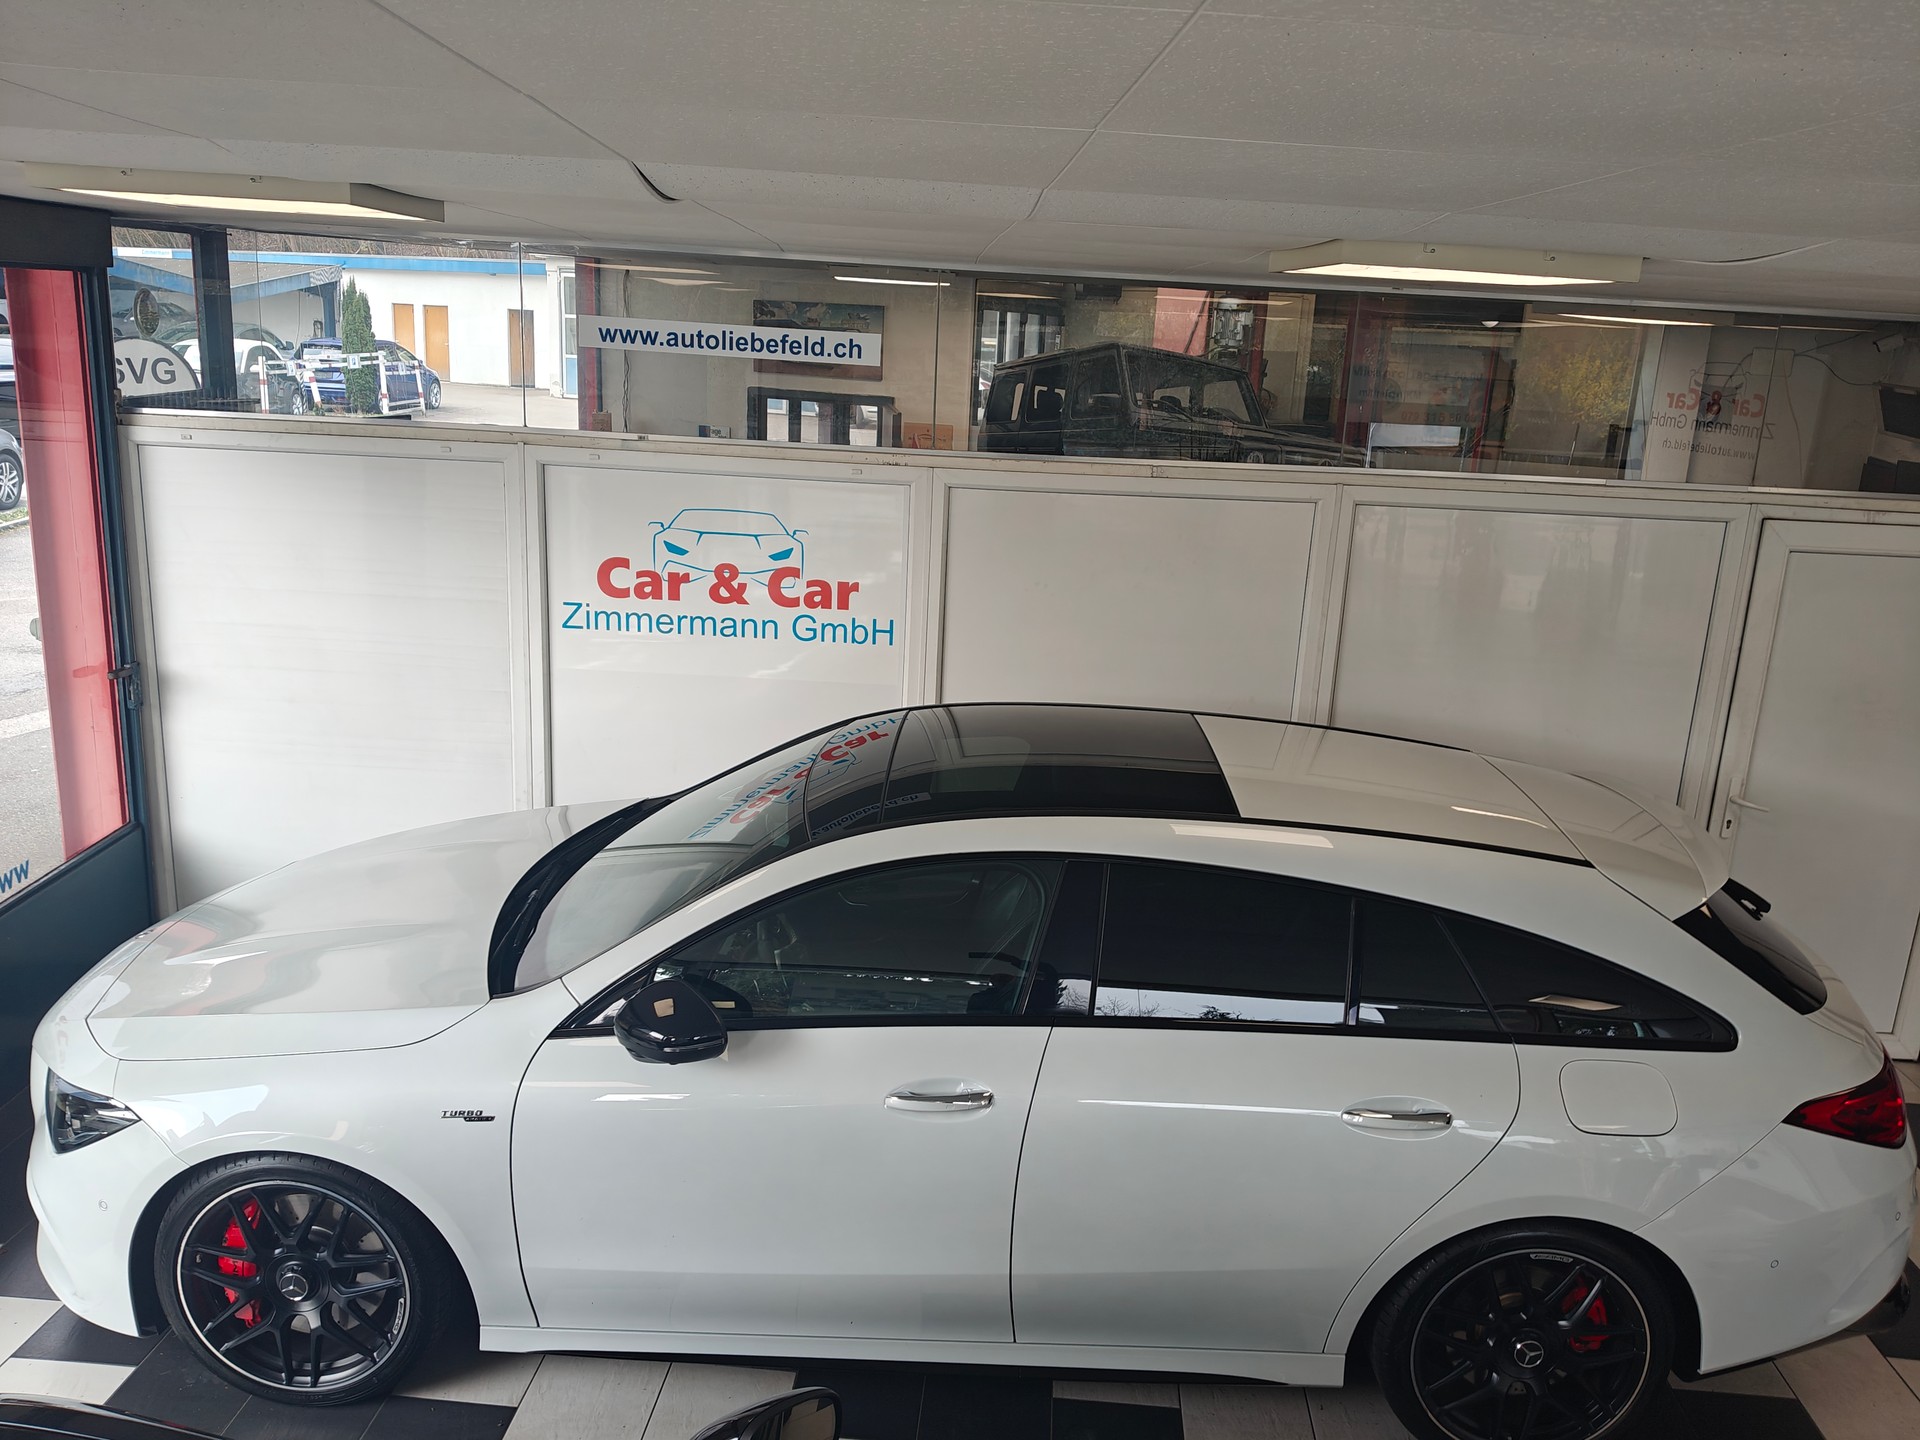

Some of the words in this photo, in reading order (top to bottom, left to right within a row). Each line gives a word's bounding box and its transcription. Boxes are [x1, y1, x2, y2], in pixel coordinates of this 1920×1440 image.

[598, 326, 863, 360] www.autoliebefeld.ch
[596, 556, 691, 602] Car
[708, 562, 750, 606] &
[767, 566, 860, 611] Car
[561, 601, 779, 640] Zimmermann
[792, 614, 895, 646] GmbH
